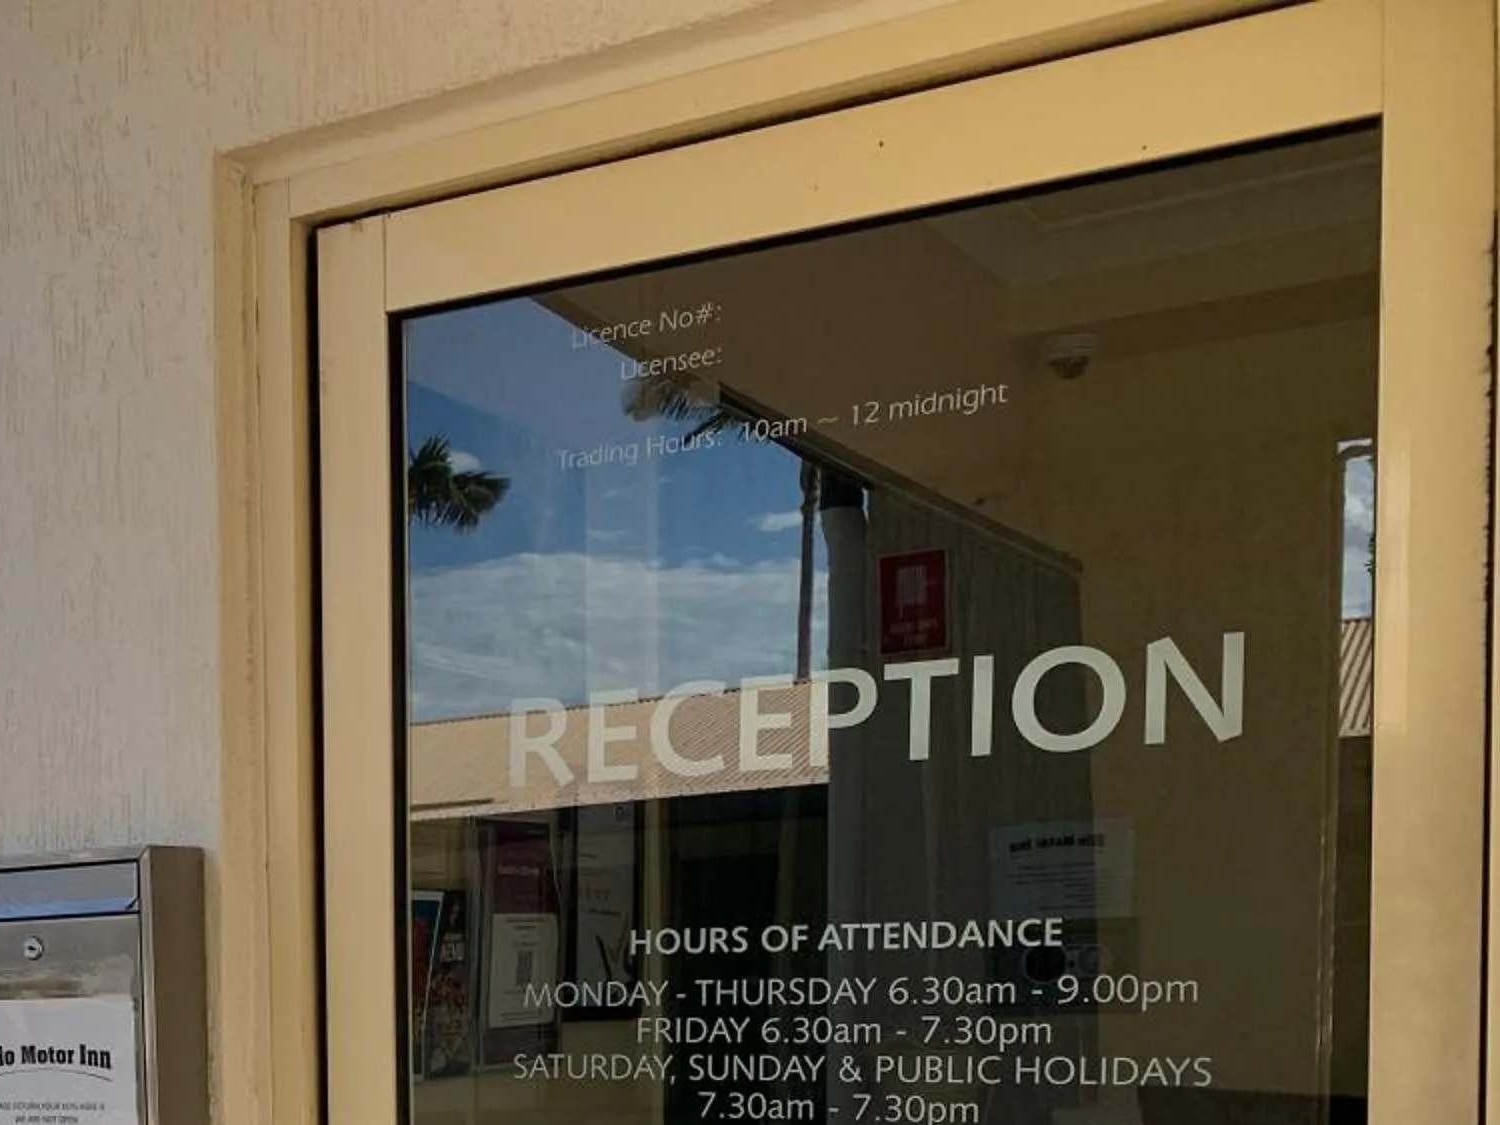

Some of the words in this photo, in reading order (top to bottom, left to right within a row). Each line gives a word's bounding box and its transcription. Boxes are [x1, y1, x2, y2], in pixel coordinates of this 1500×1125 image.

[571, 317, 653, 349] Licence
[621, 347, 723, 380] Licensee:
[558, 441, 639, 472] Trading
[646, 429, 723, 456] Hours:
[741, 416, 808, 442] 10am
[851, 400, 880, 427] 12
[888, 383, 1010, 422] midnight
[508, 632, 1246, 787] RECEPTION
[630, 926, 749, 955] HOURS
[761, 925, 809, 952] OF
[817, 918, 1063, 951] ATTENDANCE
[523, 980, 669, 1008] MONDAY
[695, 977, 878, 1006] THURSDAY
[888, 976, 1017, 1006] 6.30am
[1056, 974, 1199, 1012] 9.00pm
[636, 1017, 751, 1045] FRIDAY
[761, 1016, 882, 1045] 6.30am
[920, 1015, 1052, 1053] 7.30pm
[21, 1044, 75, 1065] Motor
[79, 1043, 112, 1071] Inn
[513, 1053, 676, 1085] SATURDAY,
[688, 1054, 826, 1083] SUNDAY
[838, 1055, 863, 1084] &
[875, 1055, 1002, 1084] PUBLIC
[1014, 1056, 1213, 1087] HOLIDAYS
[697, 1091, 815, 1120] 7.30am
